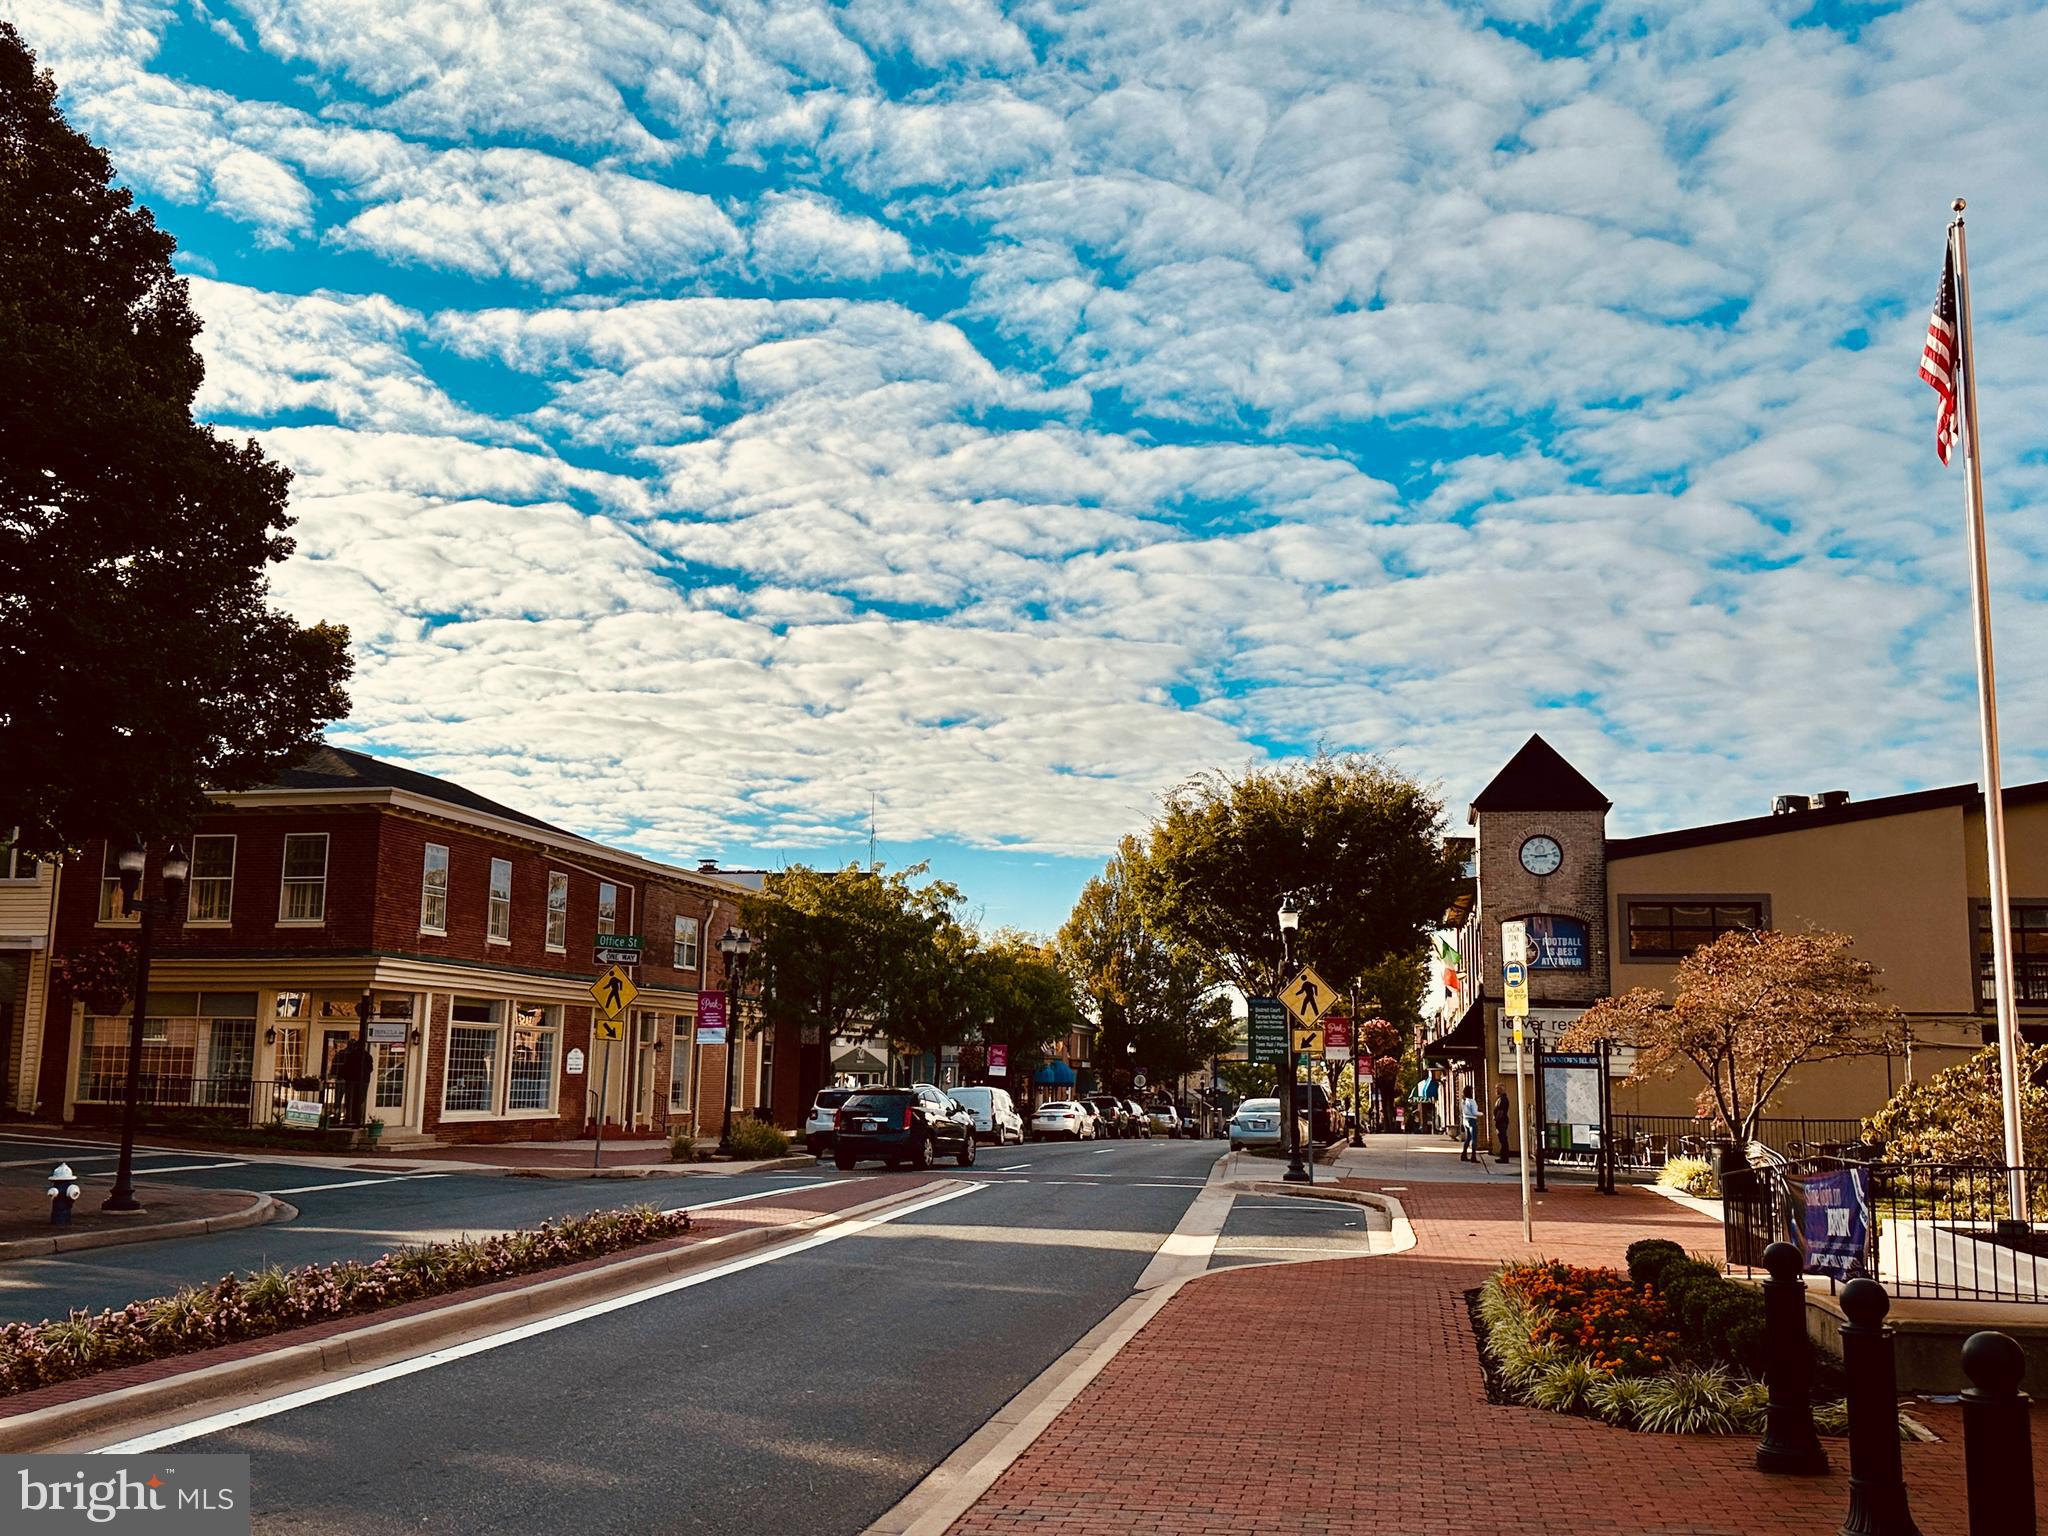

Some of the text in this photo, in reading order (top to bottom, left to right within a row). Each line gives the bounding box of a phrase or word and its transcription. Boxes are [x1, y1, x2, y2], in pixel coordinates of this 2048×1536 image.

[599, 935, 638, 948] Office St
[1542, 937, 1582, 946] FOOTBALL
[1557, 947, 1578, 956] BEST
[1541, 957, 1582, 966] AT TOWER
[1544, 1056, 1578, 1064] DOWNTOWN
